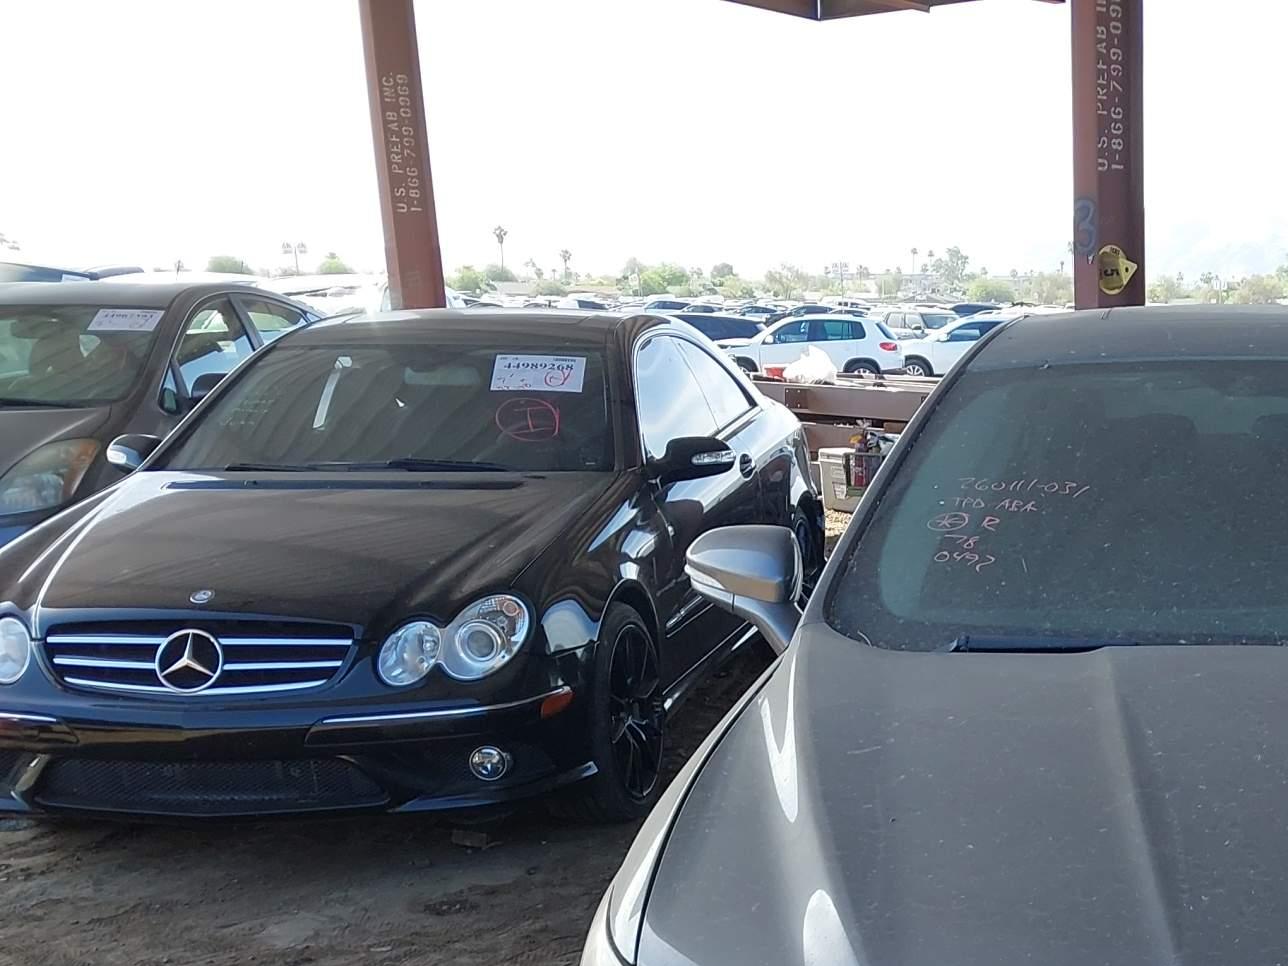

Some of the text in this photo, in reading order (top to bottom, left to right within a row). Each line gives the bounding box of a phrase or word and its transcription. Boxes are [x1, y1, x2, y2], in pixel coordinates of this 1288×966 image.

[1096, 25, 1108, 115] PREFAB
[1109, 0, 1124, 170] 1-866-799-09
[386, 111, 404, 174] PREFAB
